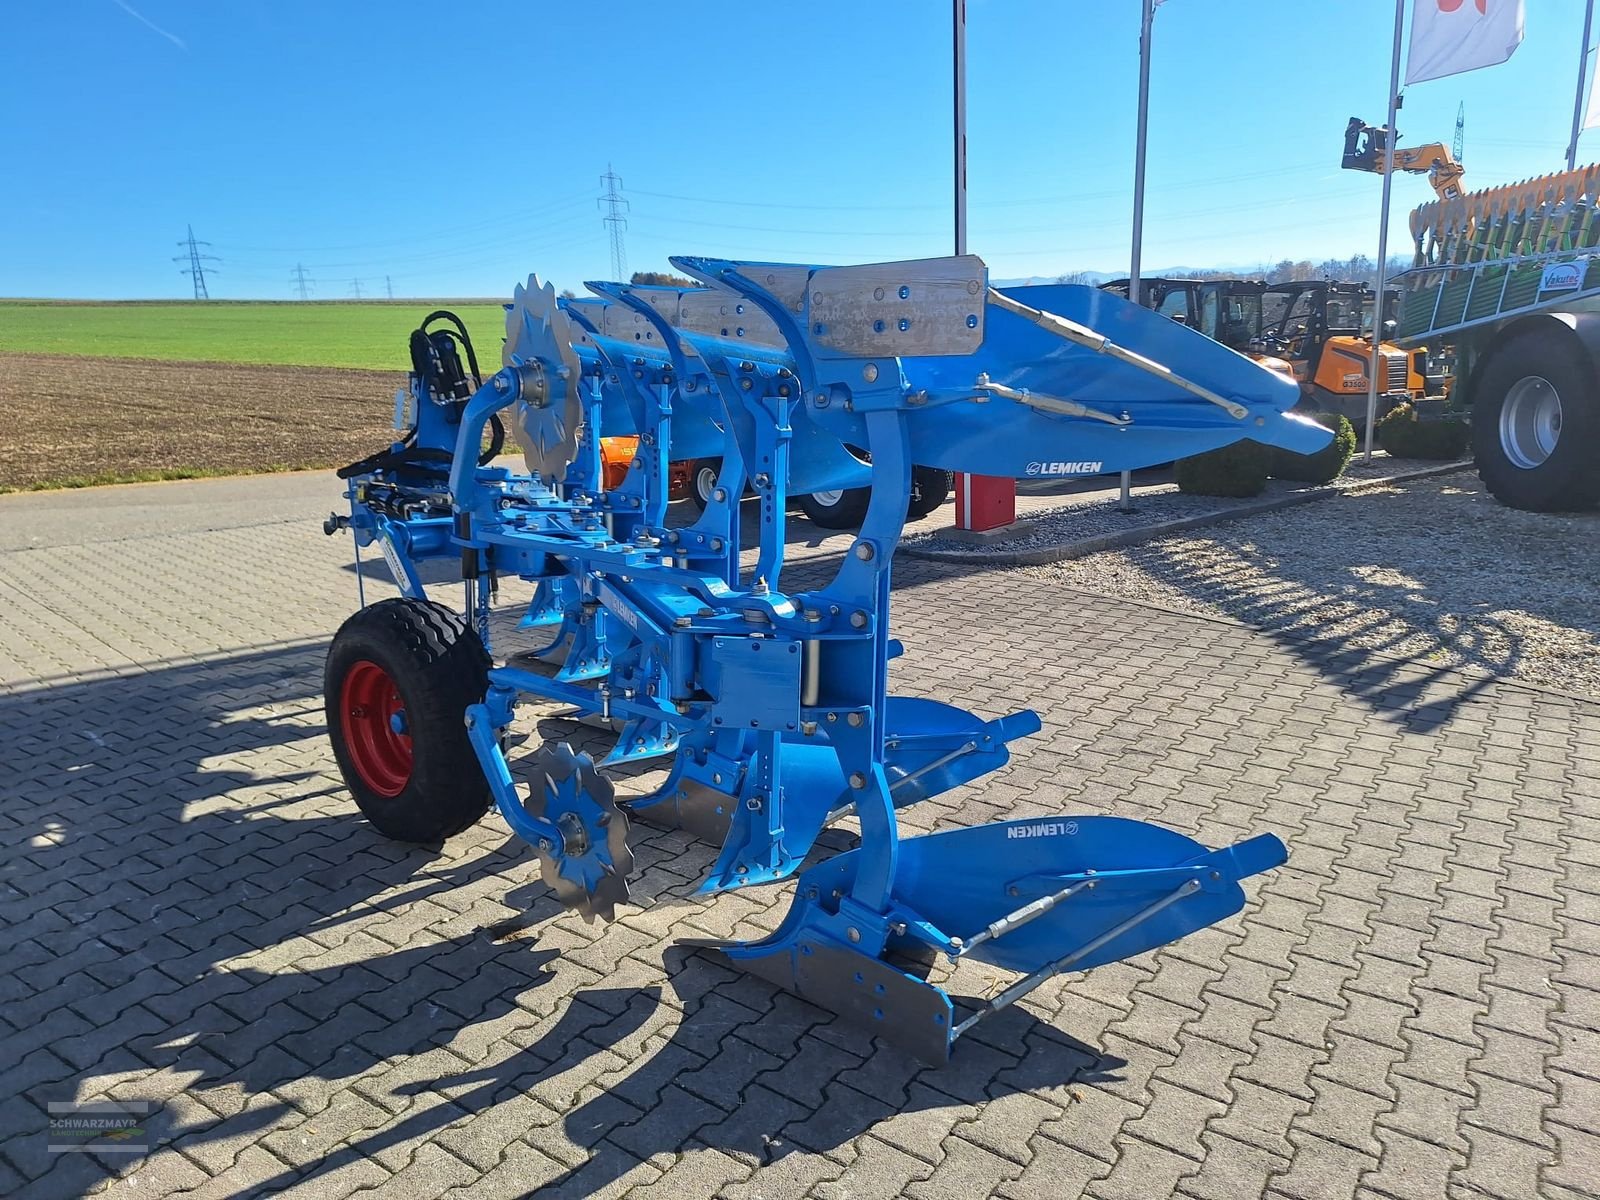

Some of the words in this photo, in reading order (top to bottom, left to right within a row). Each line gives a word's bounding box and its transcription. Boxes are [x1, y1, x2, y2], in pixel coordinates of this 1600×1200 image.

[1041, 462, 1103, 475] LEMKEN
[617, 600, 638, 631] LEMKEN
[1007, 822, 1065, 839] LEMKEN
